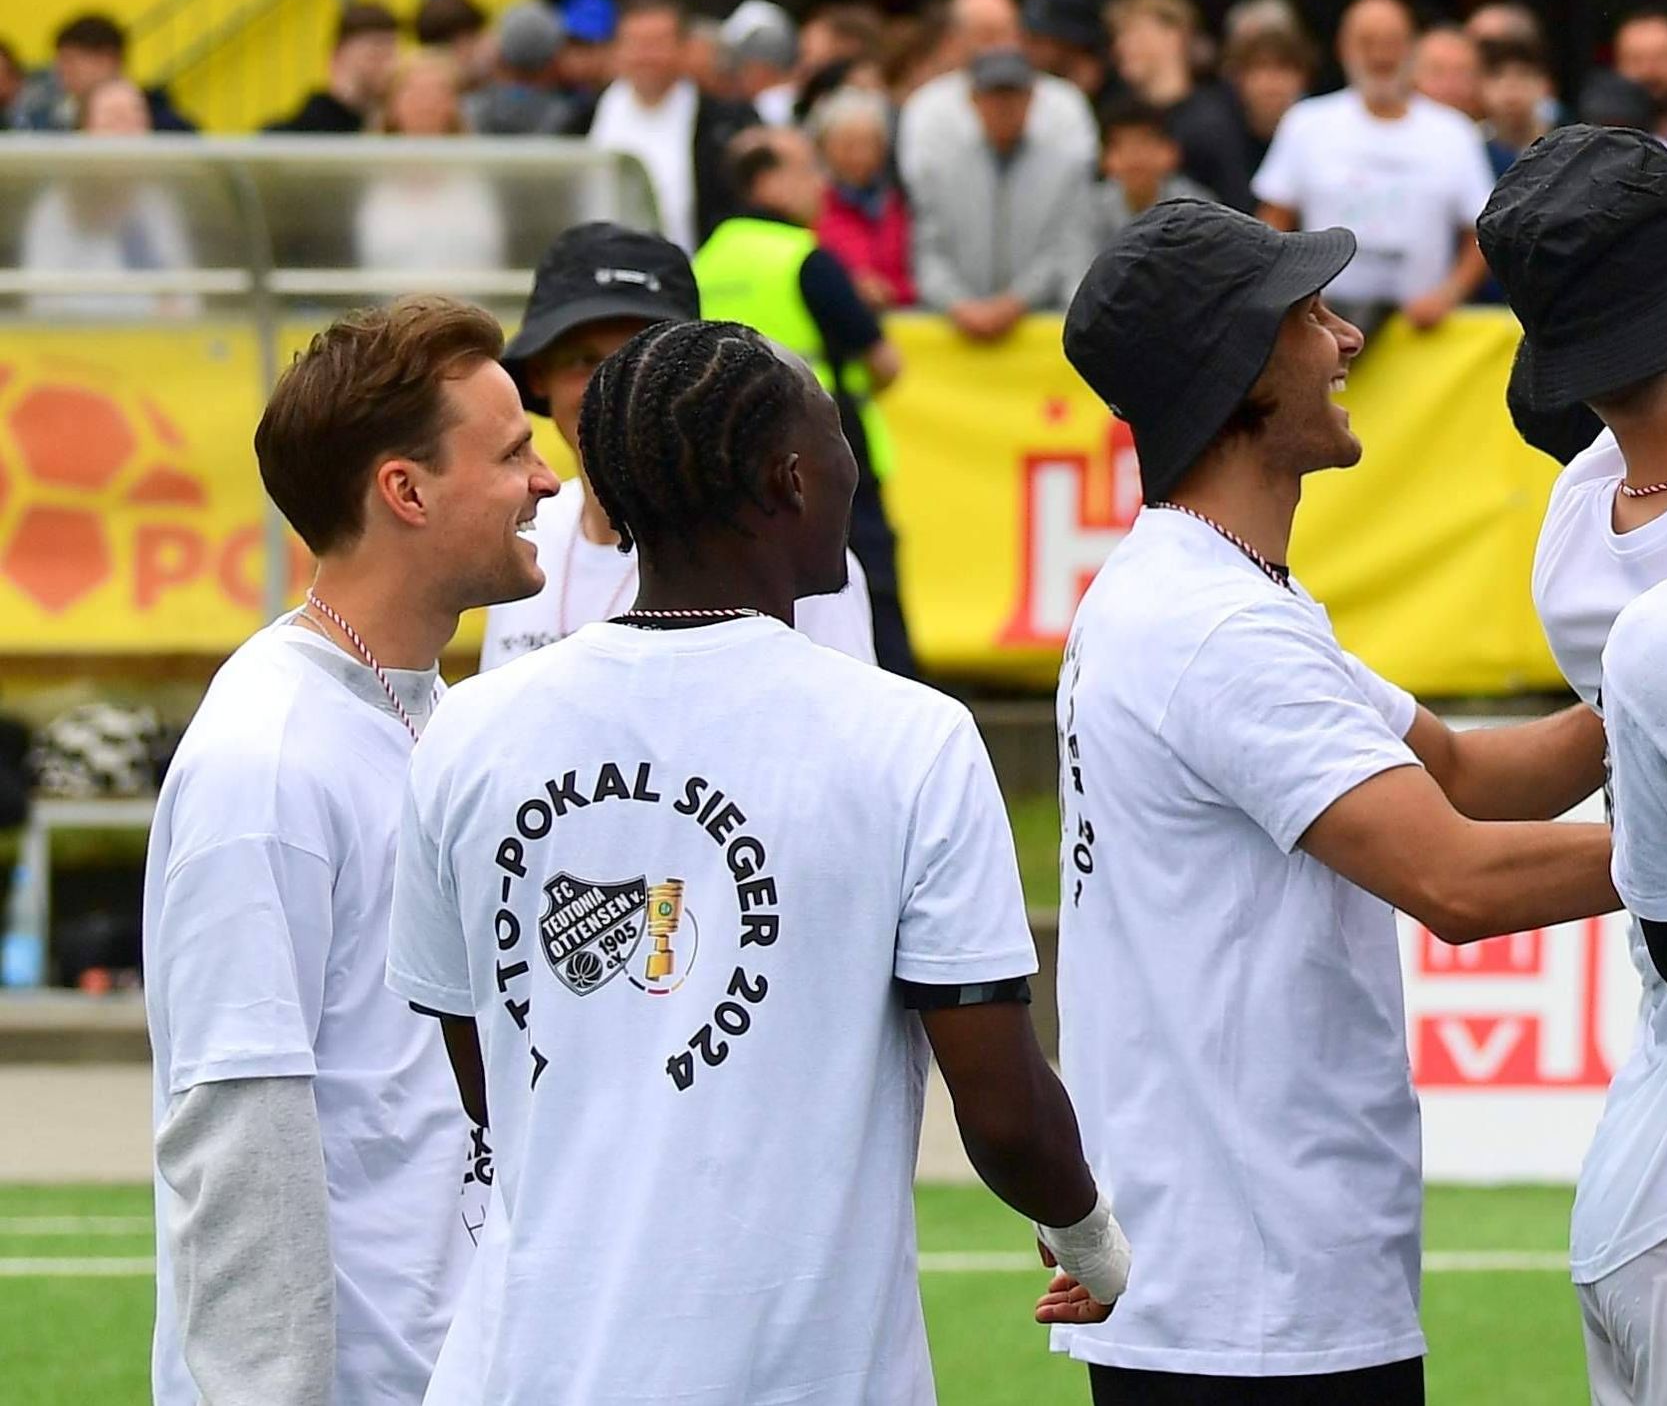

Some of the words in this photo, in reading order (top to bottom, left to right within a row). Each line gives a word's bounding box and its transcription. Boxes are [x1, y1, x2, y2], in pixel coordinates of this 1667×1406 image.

[673, 777, 780, 948] SIEGER
[542, 886, 607, 938] TEUTONIA
[551, 880, 575, 905] FC
[550, 897, 628, 958] OTTENSEN
[598, 920, 638, 956] 1905
[666, 966, 769, 1092] 2024
